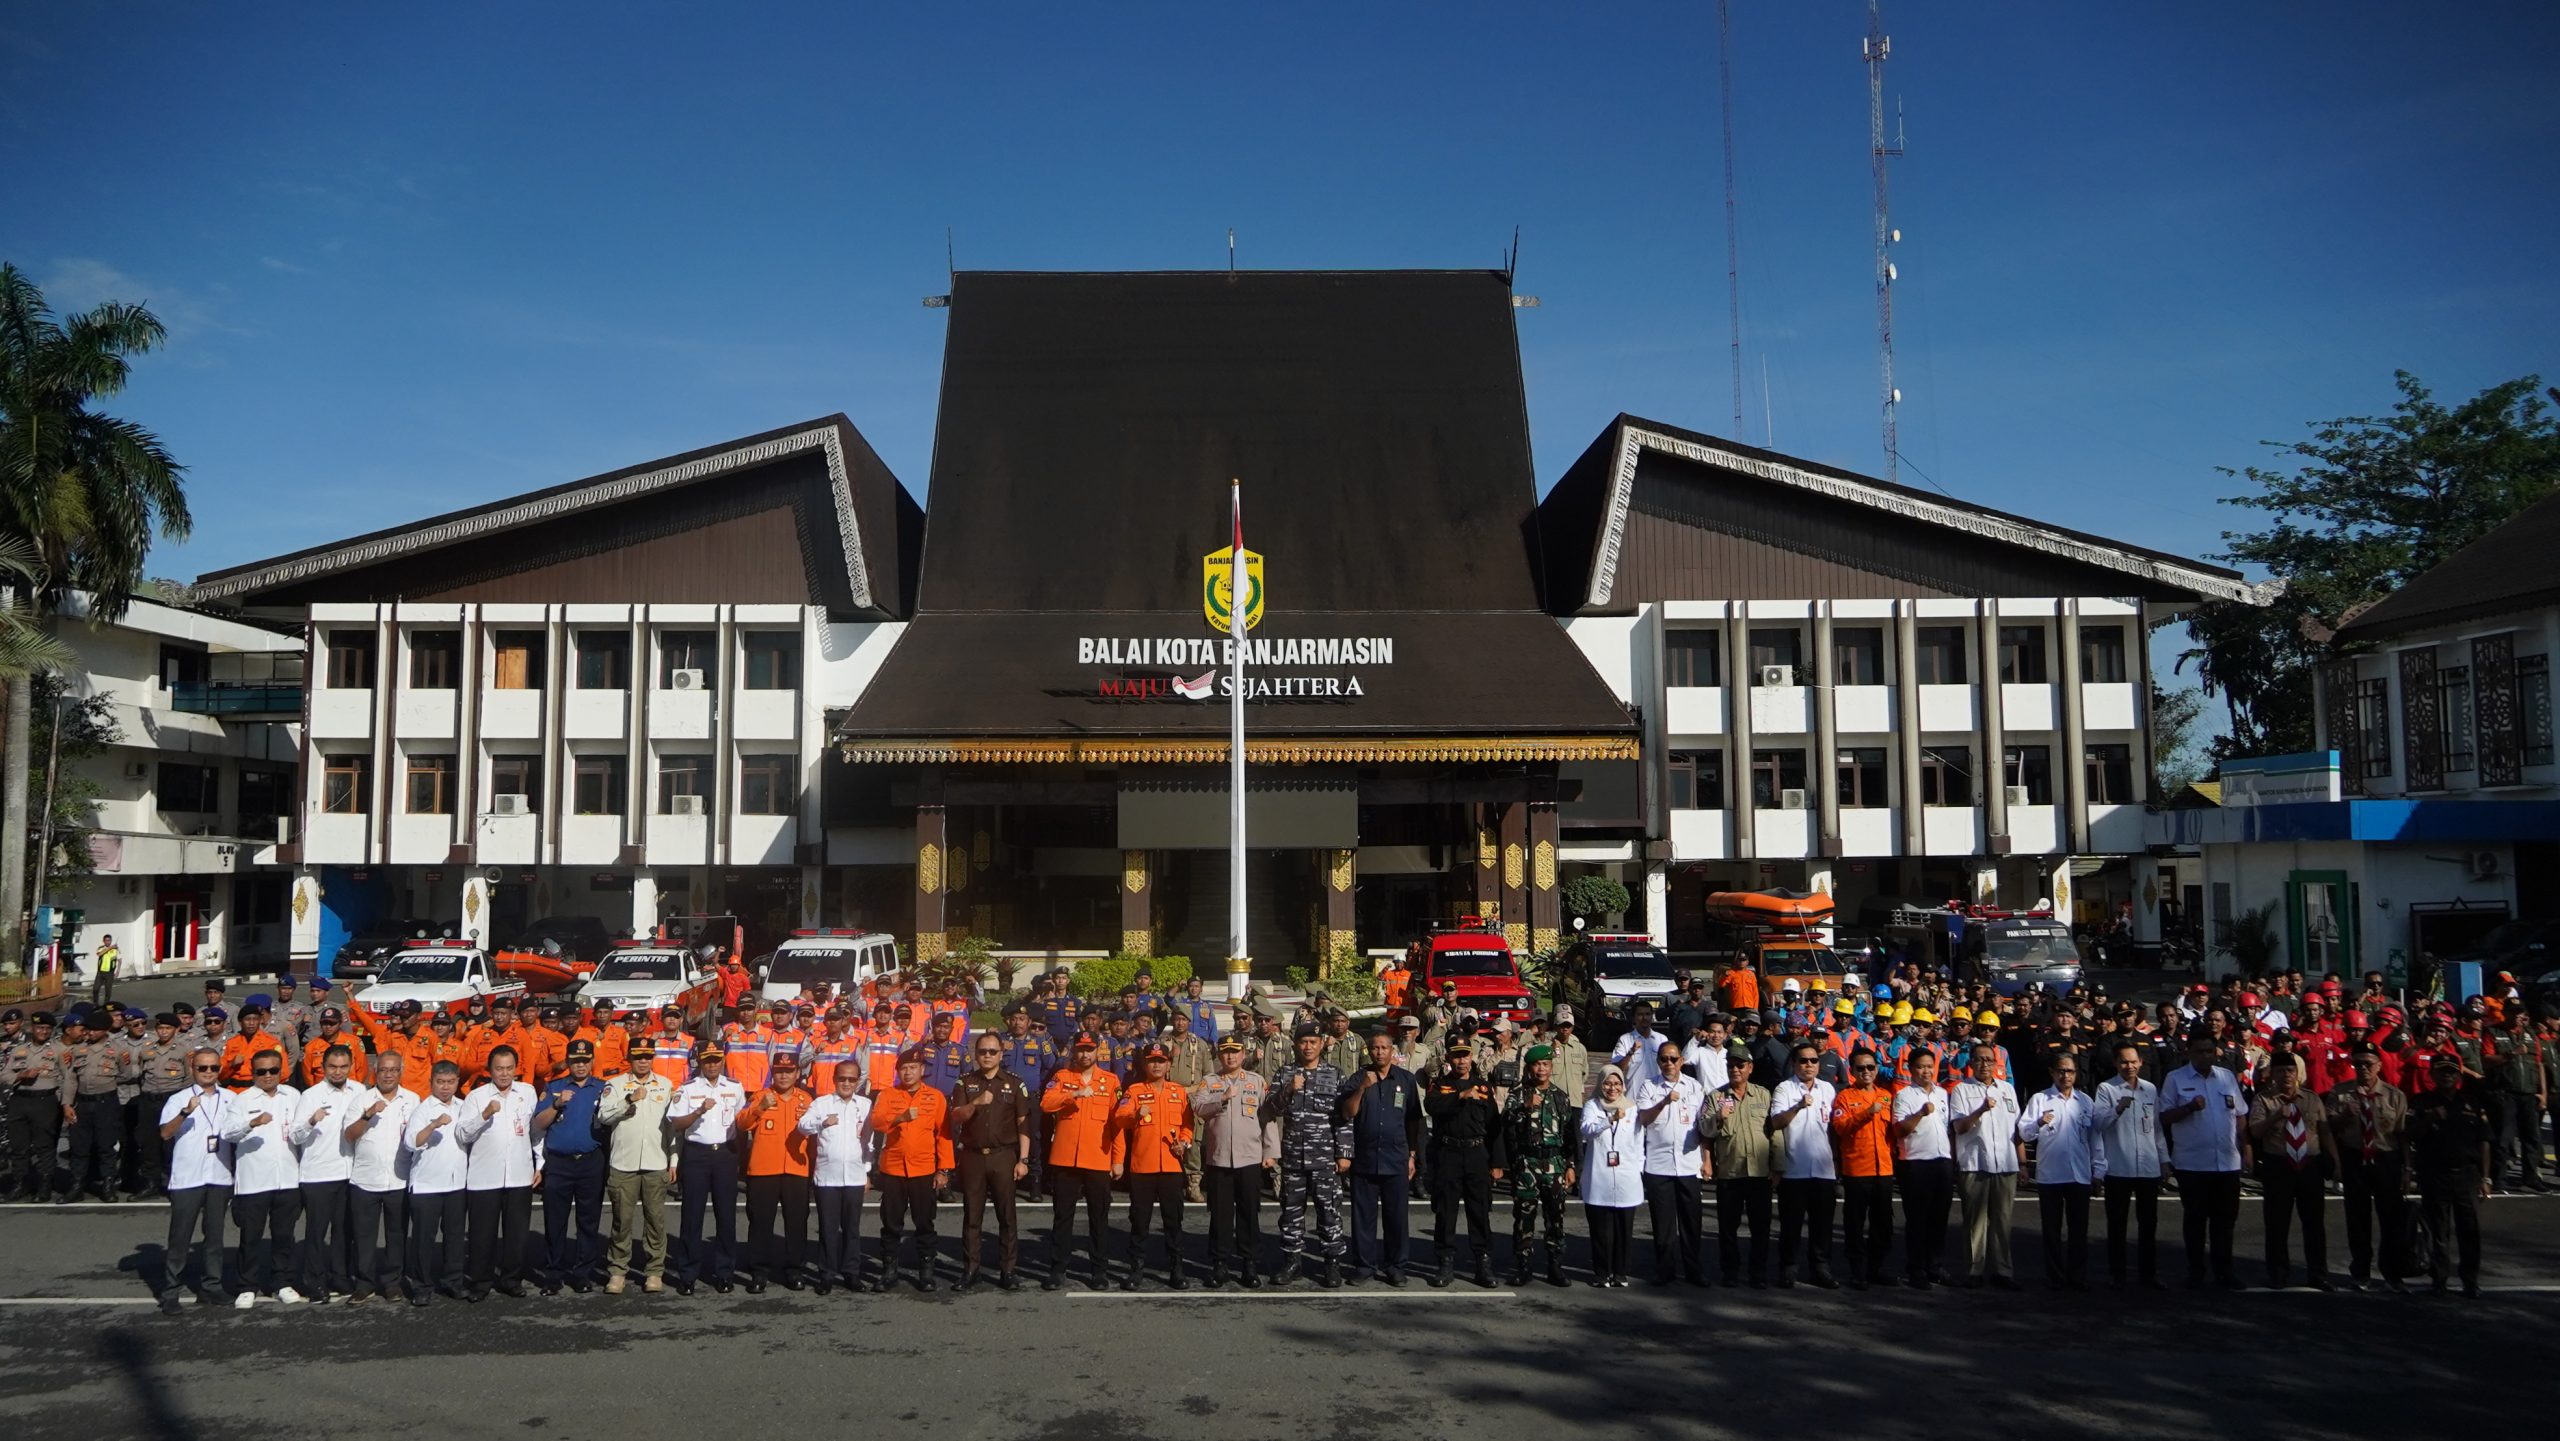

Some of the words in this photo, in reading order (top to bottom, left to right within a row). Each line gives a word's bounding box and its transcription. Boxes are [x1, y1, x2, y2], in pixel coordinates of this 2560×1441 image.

[1078, 637, 1150, 664] BALAI
[1156, 637, 1216, 665] KOTA
[1099, 679, 1167, 699] MAJU
[788, 949, 844, 958] PERINTIS
[399, 956, 457, 964] PERINTIS
[614, 955, 670, 963] PERINTIS
